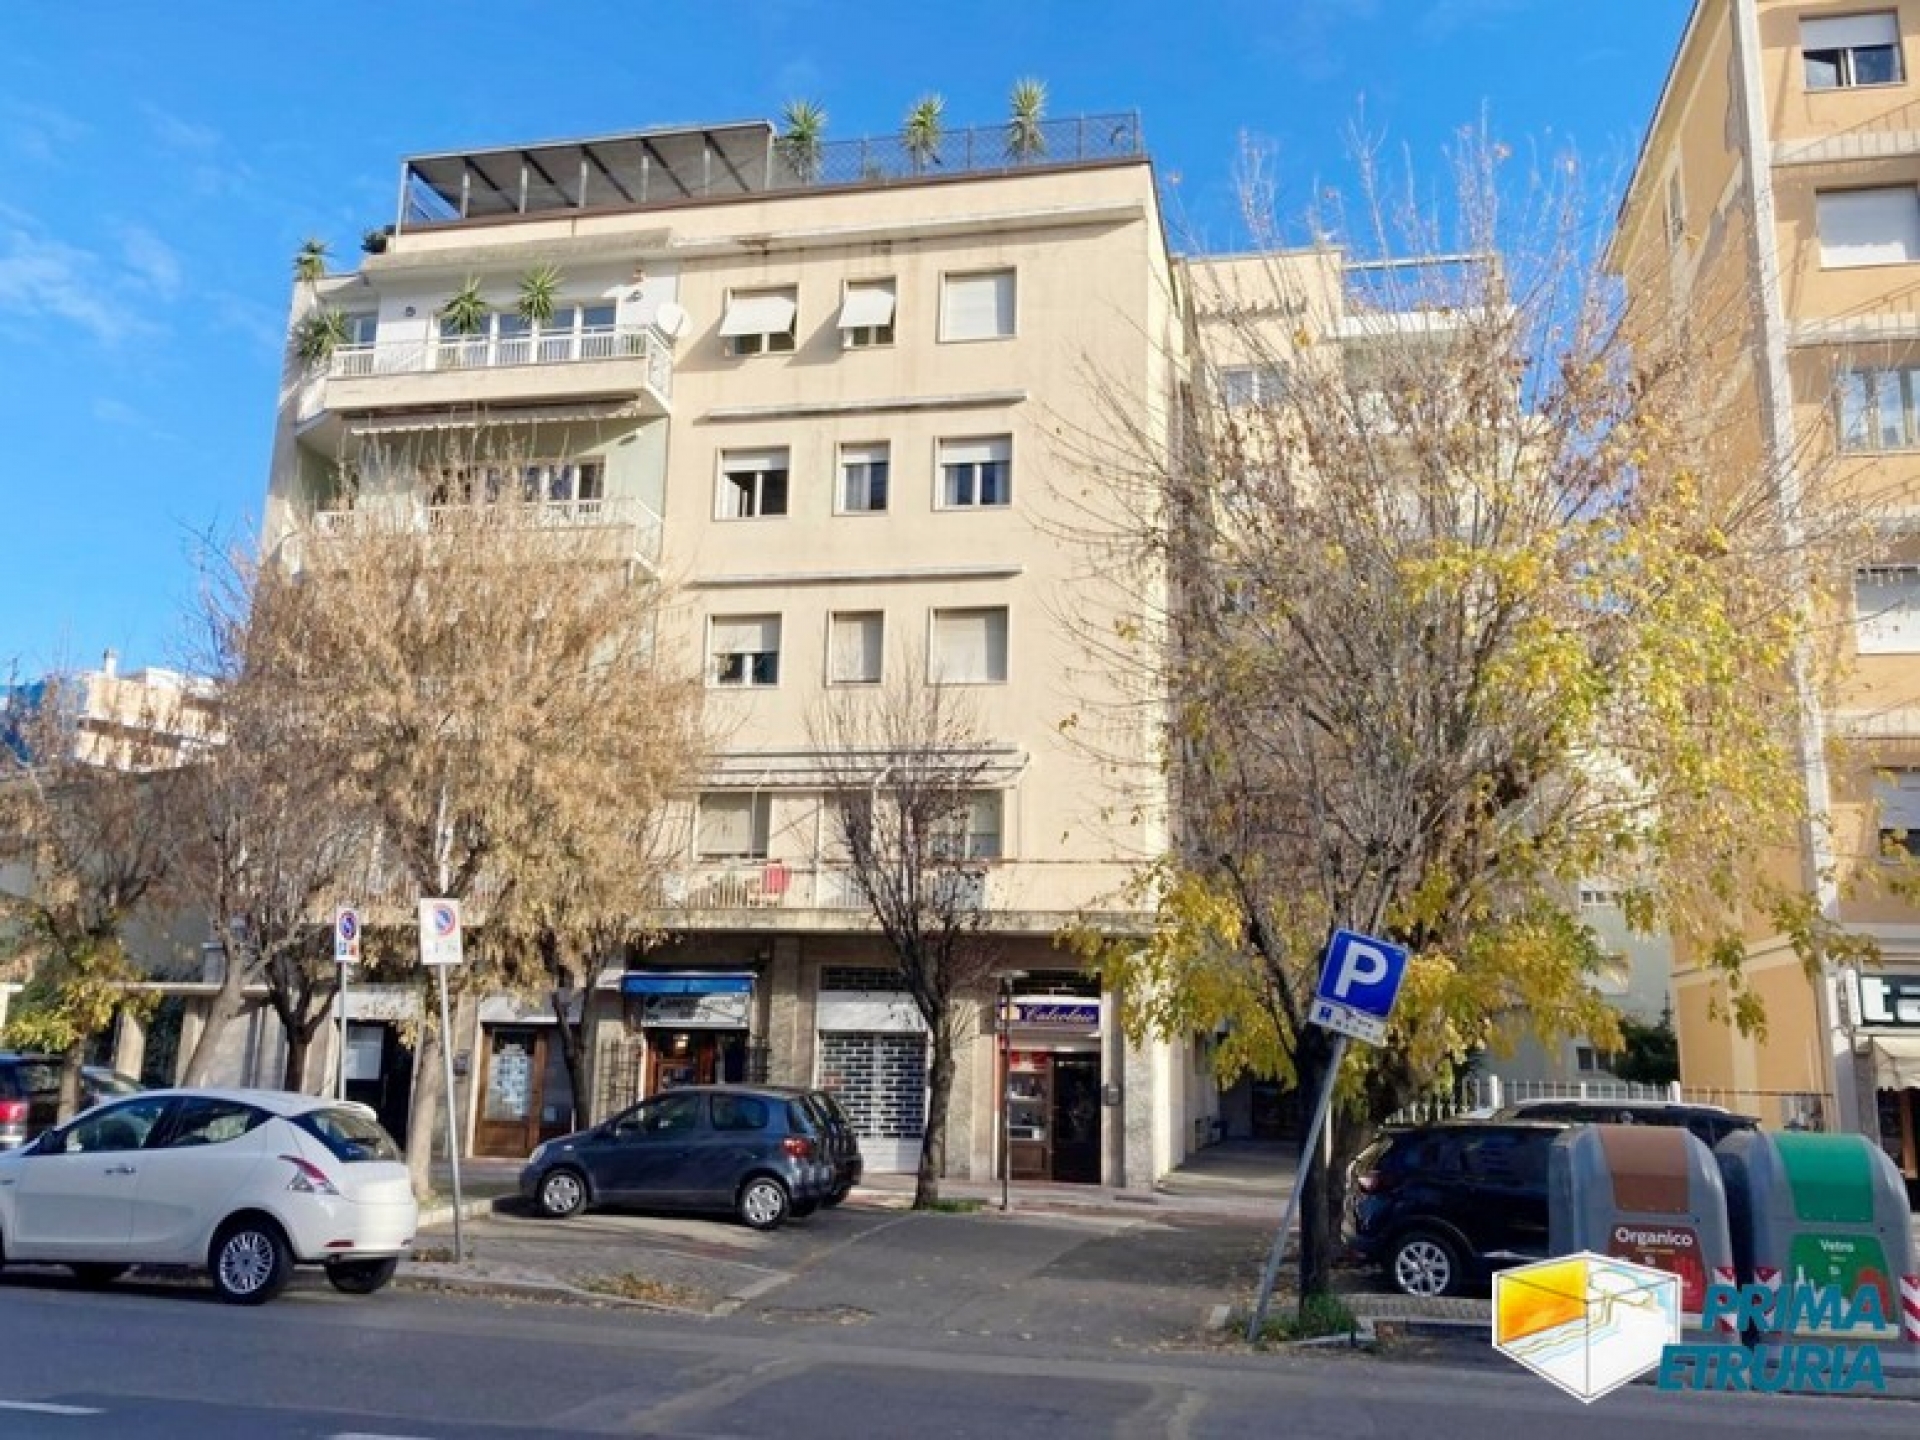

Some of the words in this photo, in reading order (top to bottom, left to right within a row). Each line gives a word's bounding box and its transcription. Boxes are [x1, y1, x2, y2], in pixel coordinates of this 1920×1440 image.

[1334, 940, 1388, 998] P
[1615, 1226, 1693, 1247] Organico
[1820, 1239, 1854, 1252] Vetro
